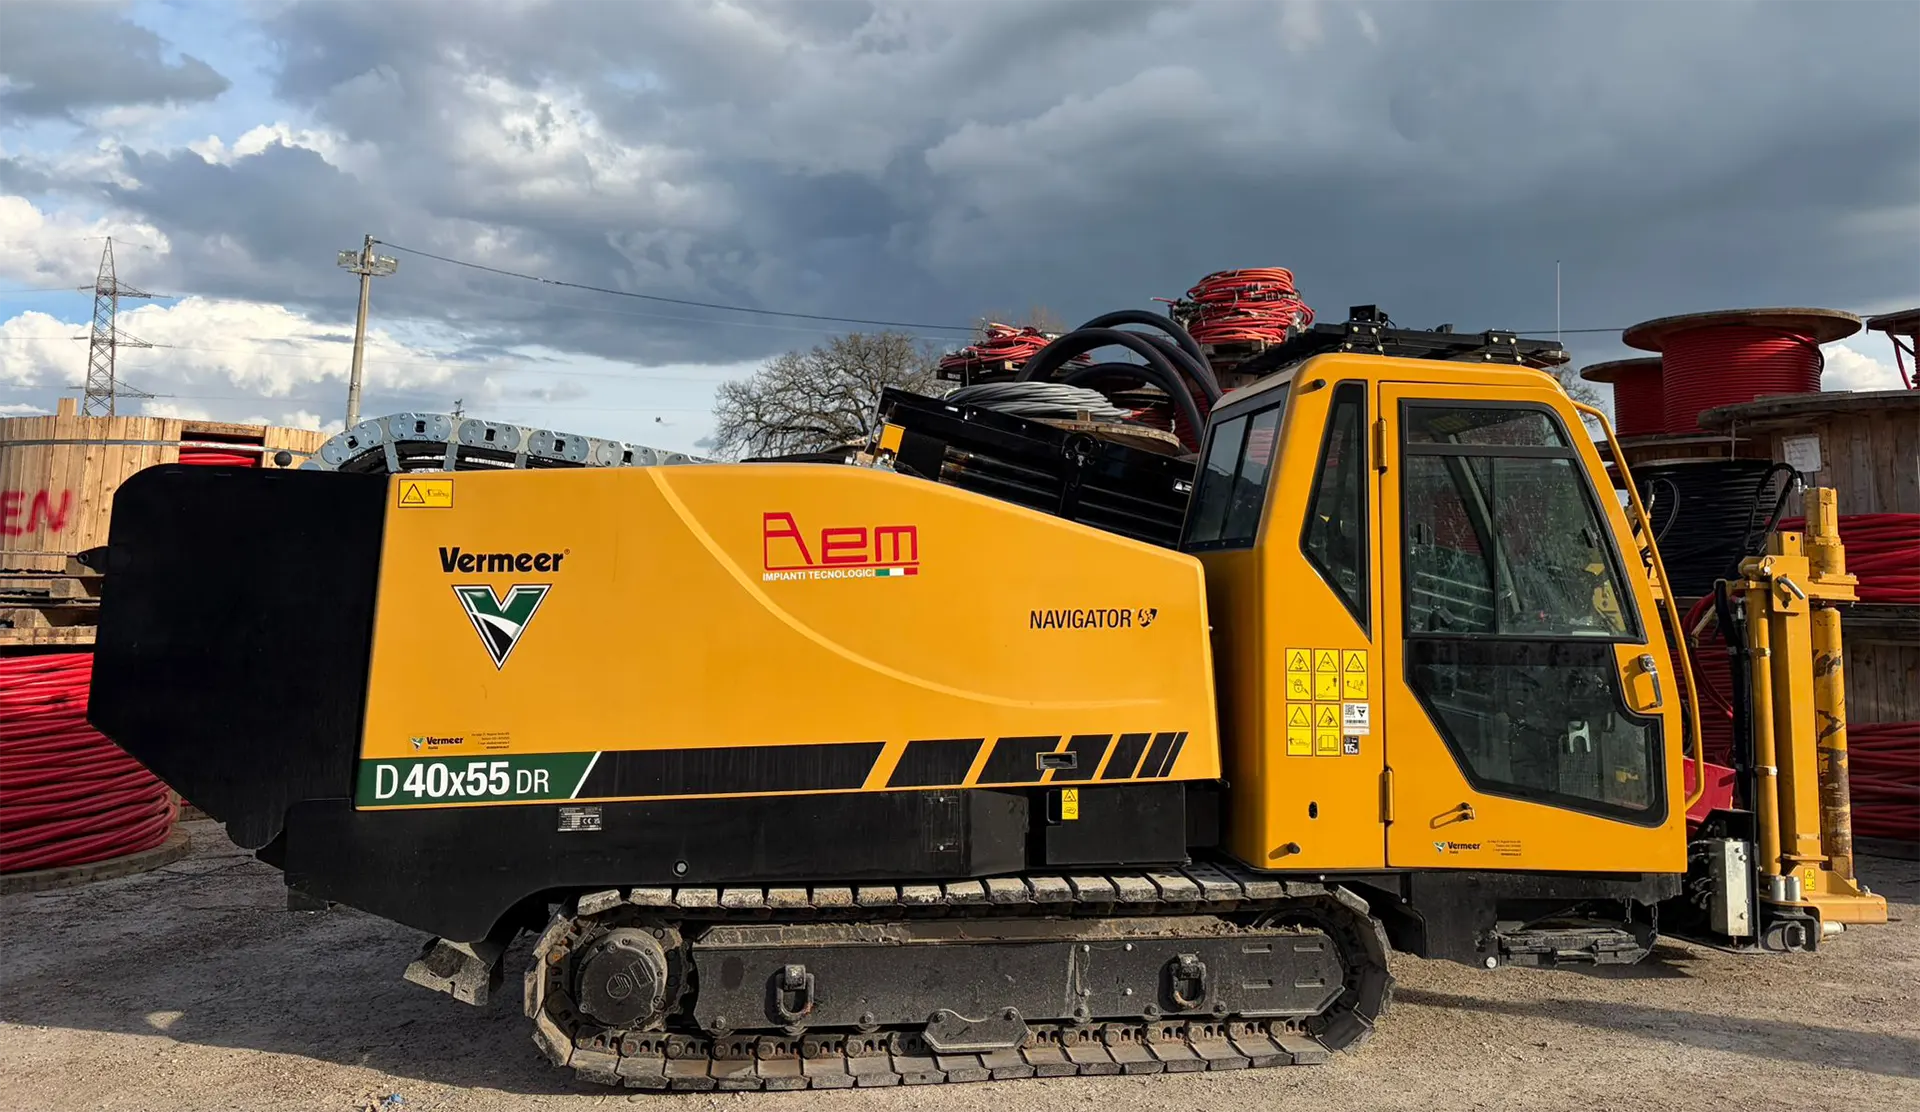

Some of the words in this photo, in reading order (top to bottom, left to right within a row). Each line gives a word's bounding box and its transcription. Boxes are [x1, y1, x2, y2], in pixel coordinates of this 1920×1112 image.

[762, 571, 806, 581] IMPIANTI
[808, 568, 876, 579] TECNOLOGICI
[1030, 609, 1132, 629] NAVIGATOR
[426, 736, 464, 745] Vermeer
[375, 764, 399, 800] D
[402, 761, 510, 798] 40x55
[516, 769, 550, 795] DR
[1447, 841, 1481, 850] Vermeer
